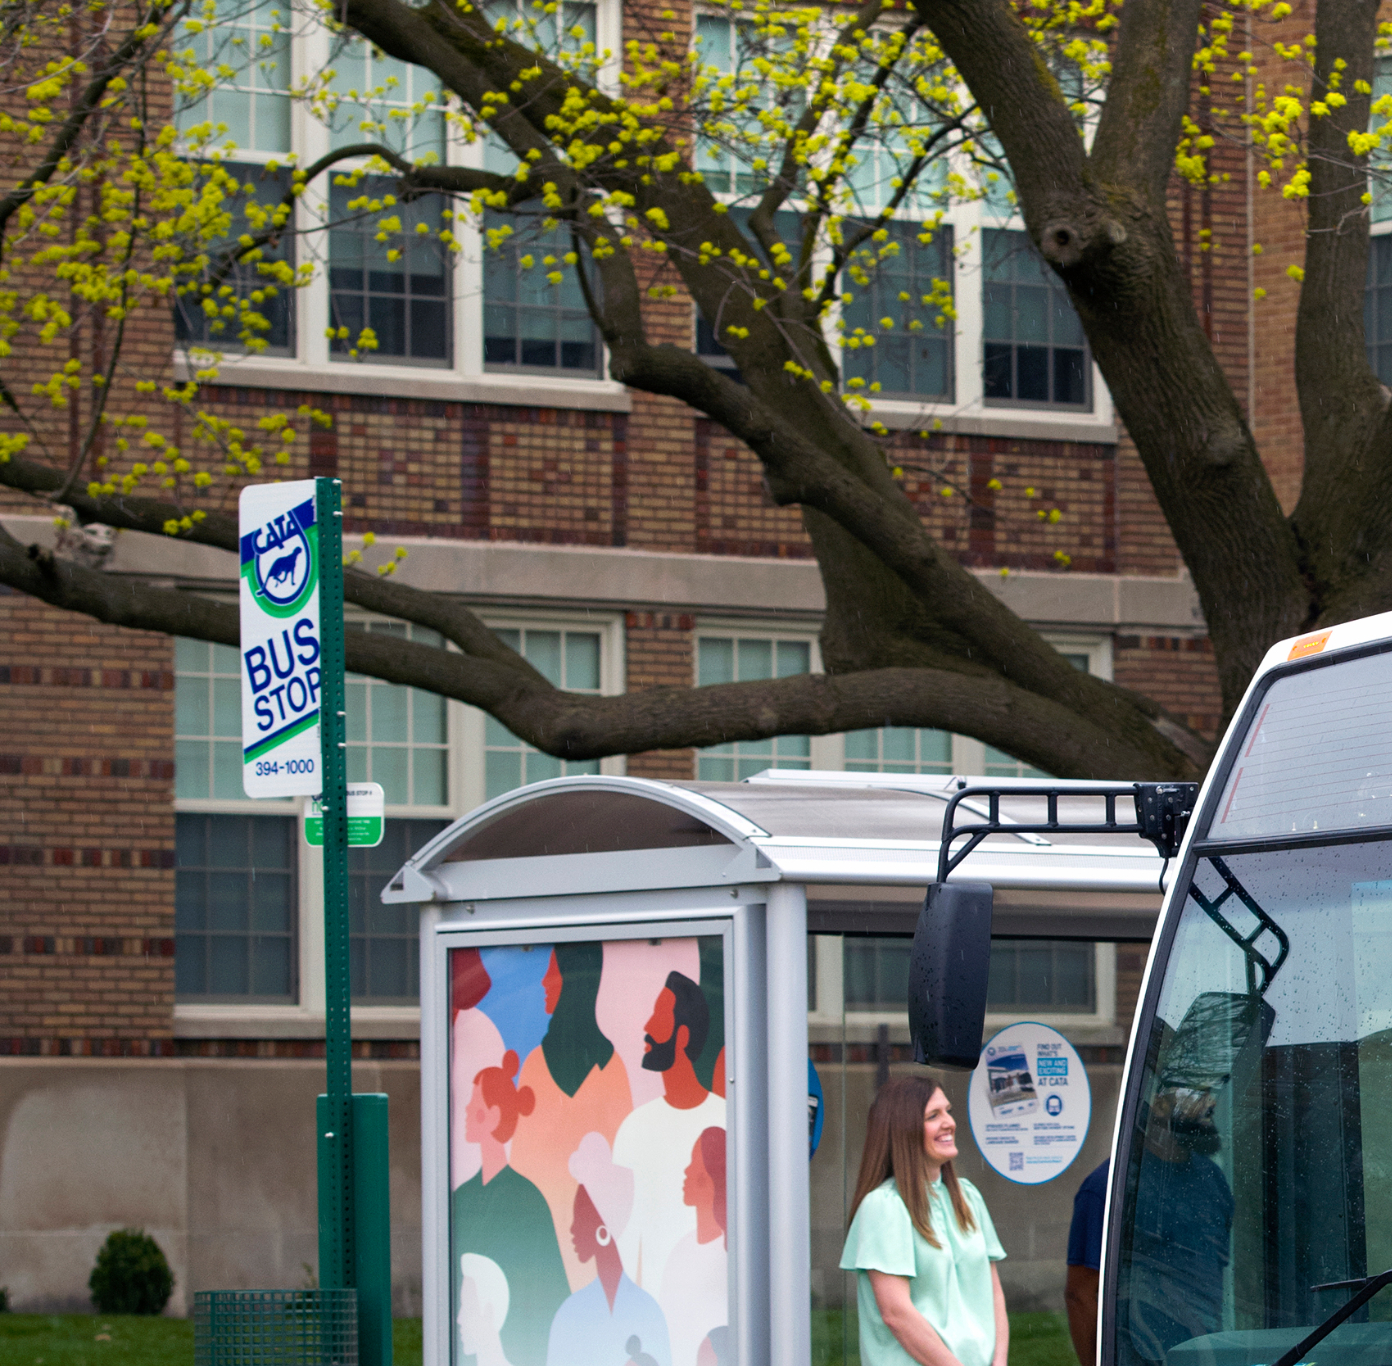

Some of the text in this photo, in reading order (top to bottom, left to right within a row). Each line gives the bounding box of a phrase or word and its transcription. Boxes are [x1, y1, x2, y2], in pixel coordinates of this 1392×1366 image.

[253, 510, 306, 555] CATA
[244, 618, 320, 695] BUS
[254, 666, 321, 732] STOP
[255, 758, 315, 777] 394-1000
[1038, 1077, 1068, 1086] AT CATA
